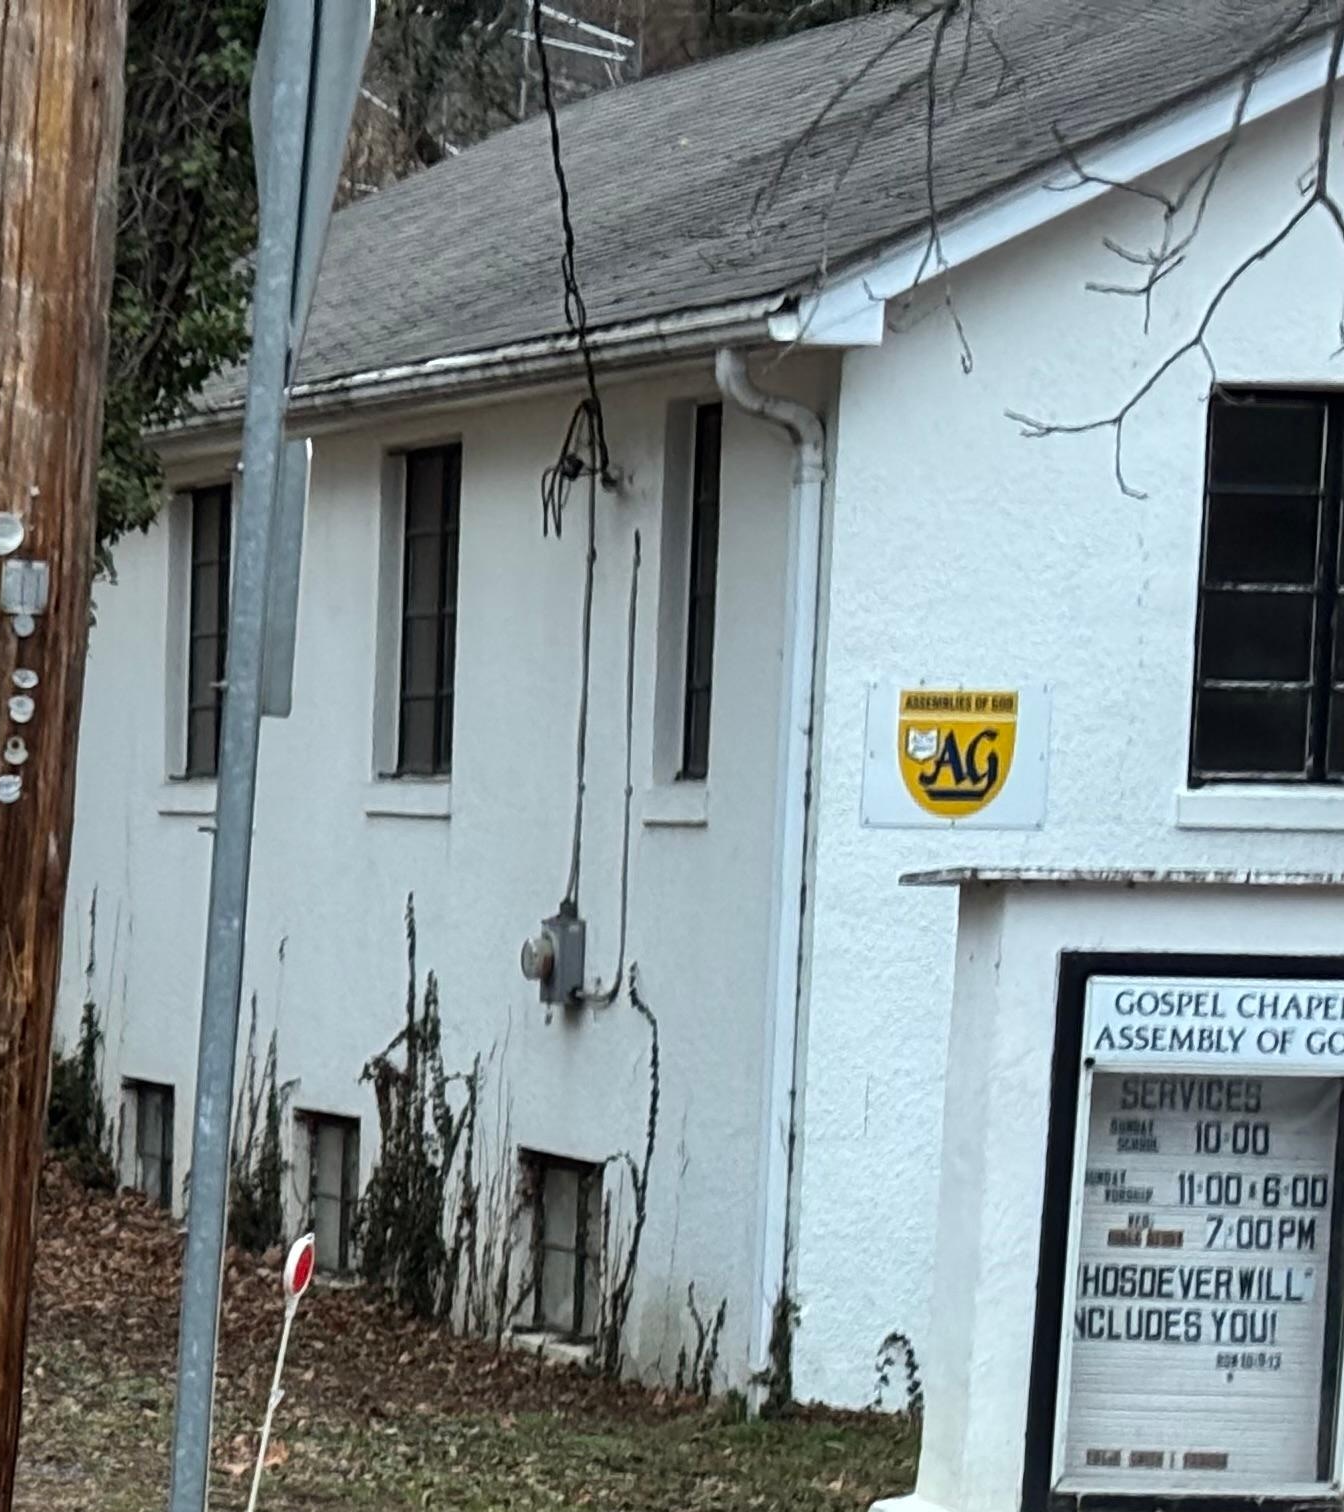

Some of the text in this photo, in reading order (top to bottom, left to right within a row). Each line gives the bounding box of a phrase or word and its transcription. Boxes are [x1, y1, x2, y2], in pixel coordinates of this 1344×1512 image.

[975, 695, 989, 713] OF
[918, 729, 1000, 798] AG
[1115, 989, 1226, 1018] GOSPEL
[1094, 1024, 1247, 1054] ASSEMBLY
[1257, 1027, 1296, 1055] OF
[1121, 1077, 1262, 1114] SERVICES
[1195, 1120, 1271, 1156] 10:00
[1178, 1170, 1242, 1206] 11:00
[1263, 1174, 1328, 1208] 6:00
[1078, 1264, 1234, 1299] HOSOEVER
[1212, 1308, 1278, 1345] YOU!
